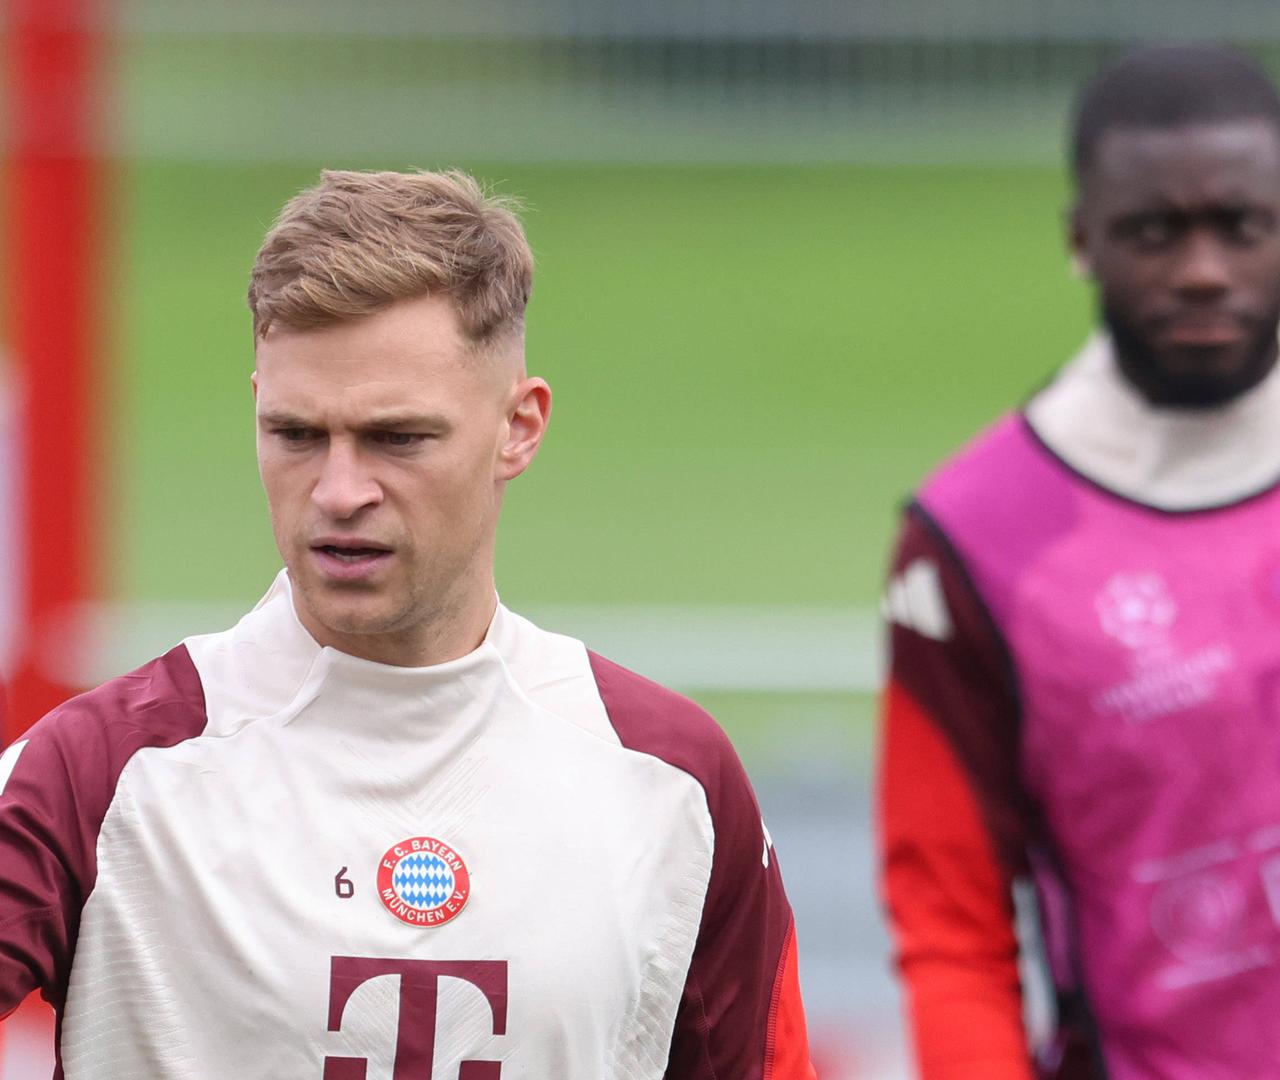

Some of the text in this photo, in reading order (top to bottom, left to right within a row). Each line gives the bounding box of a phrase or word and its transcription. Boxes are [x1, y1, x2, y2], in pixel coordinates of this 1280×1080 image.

[411, 840, 462, 872] BAYERN
[334, 866, 355, 899] 6
[382, 888, 466, 923] MÜNCHEN E.V.
